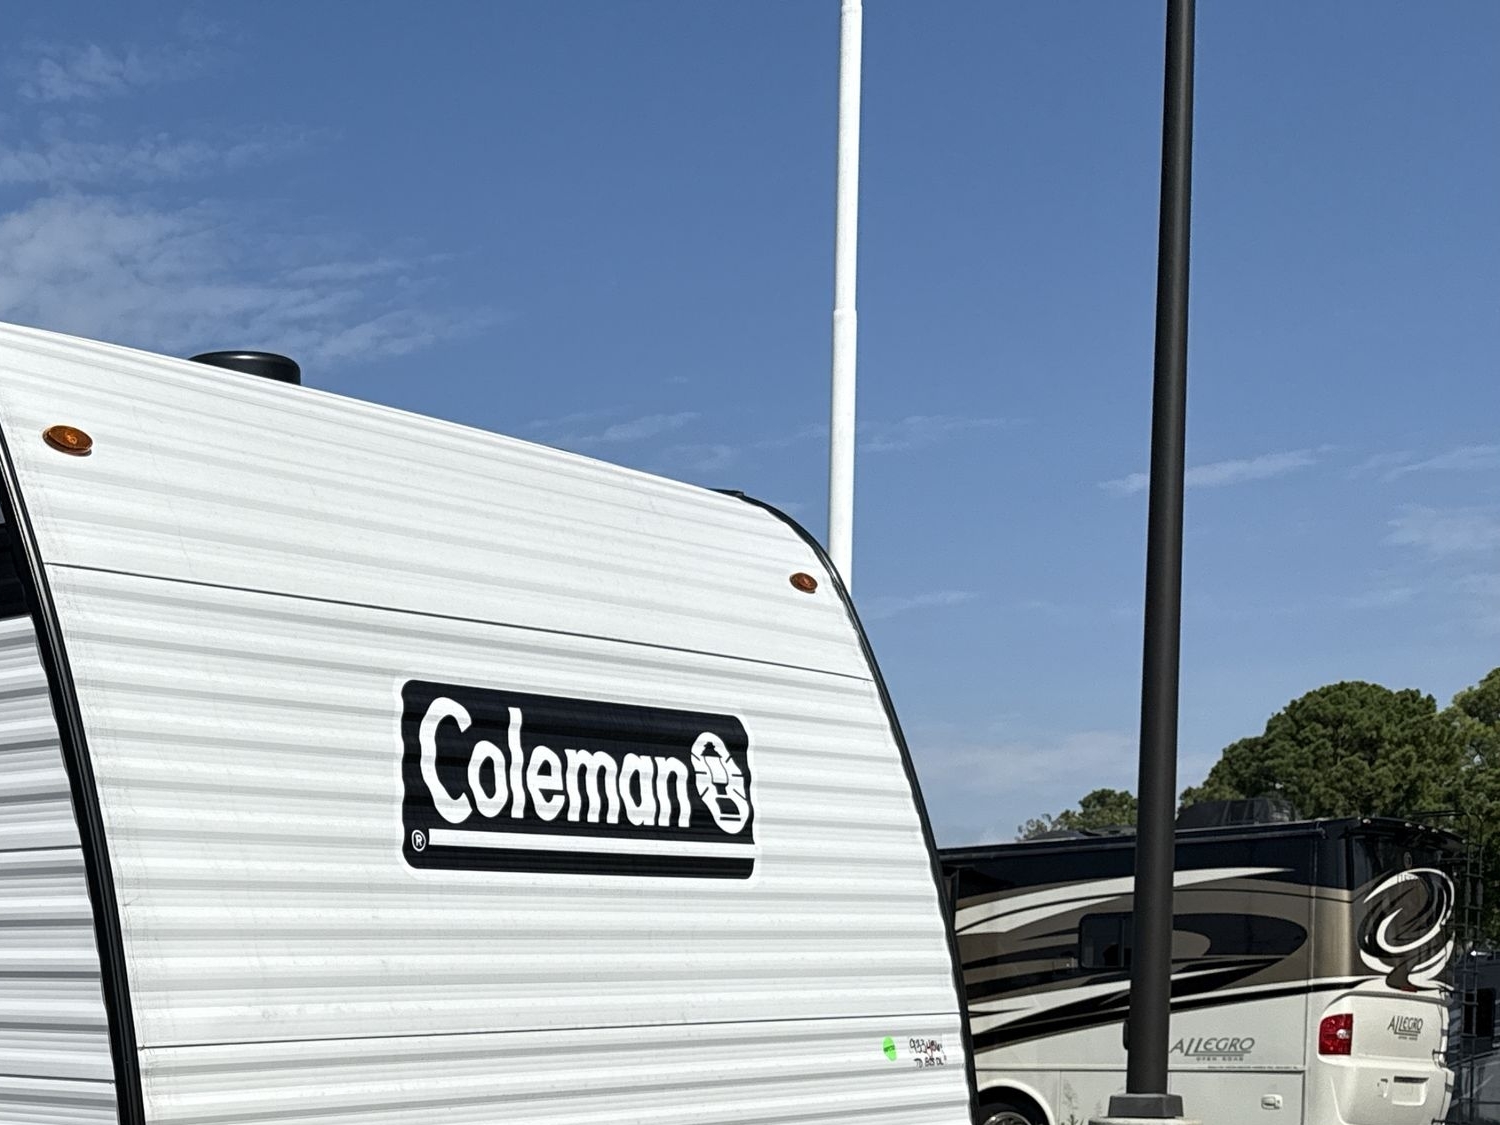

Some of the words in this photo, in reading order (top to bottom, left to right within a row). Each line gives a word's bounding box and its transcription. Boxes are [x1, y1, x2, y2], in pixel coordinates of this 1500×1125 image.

[419, 697, 690, 828] Coleman
[1387, 1016, 1424, 1036] ALLEGRO
[1169, 1037, 1255, 1056] ALLEGRO
